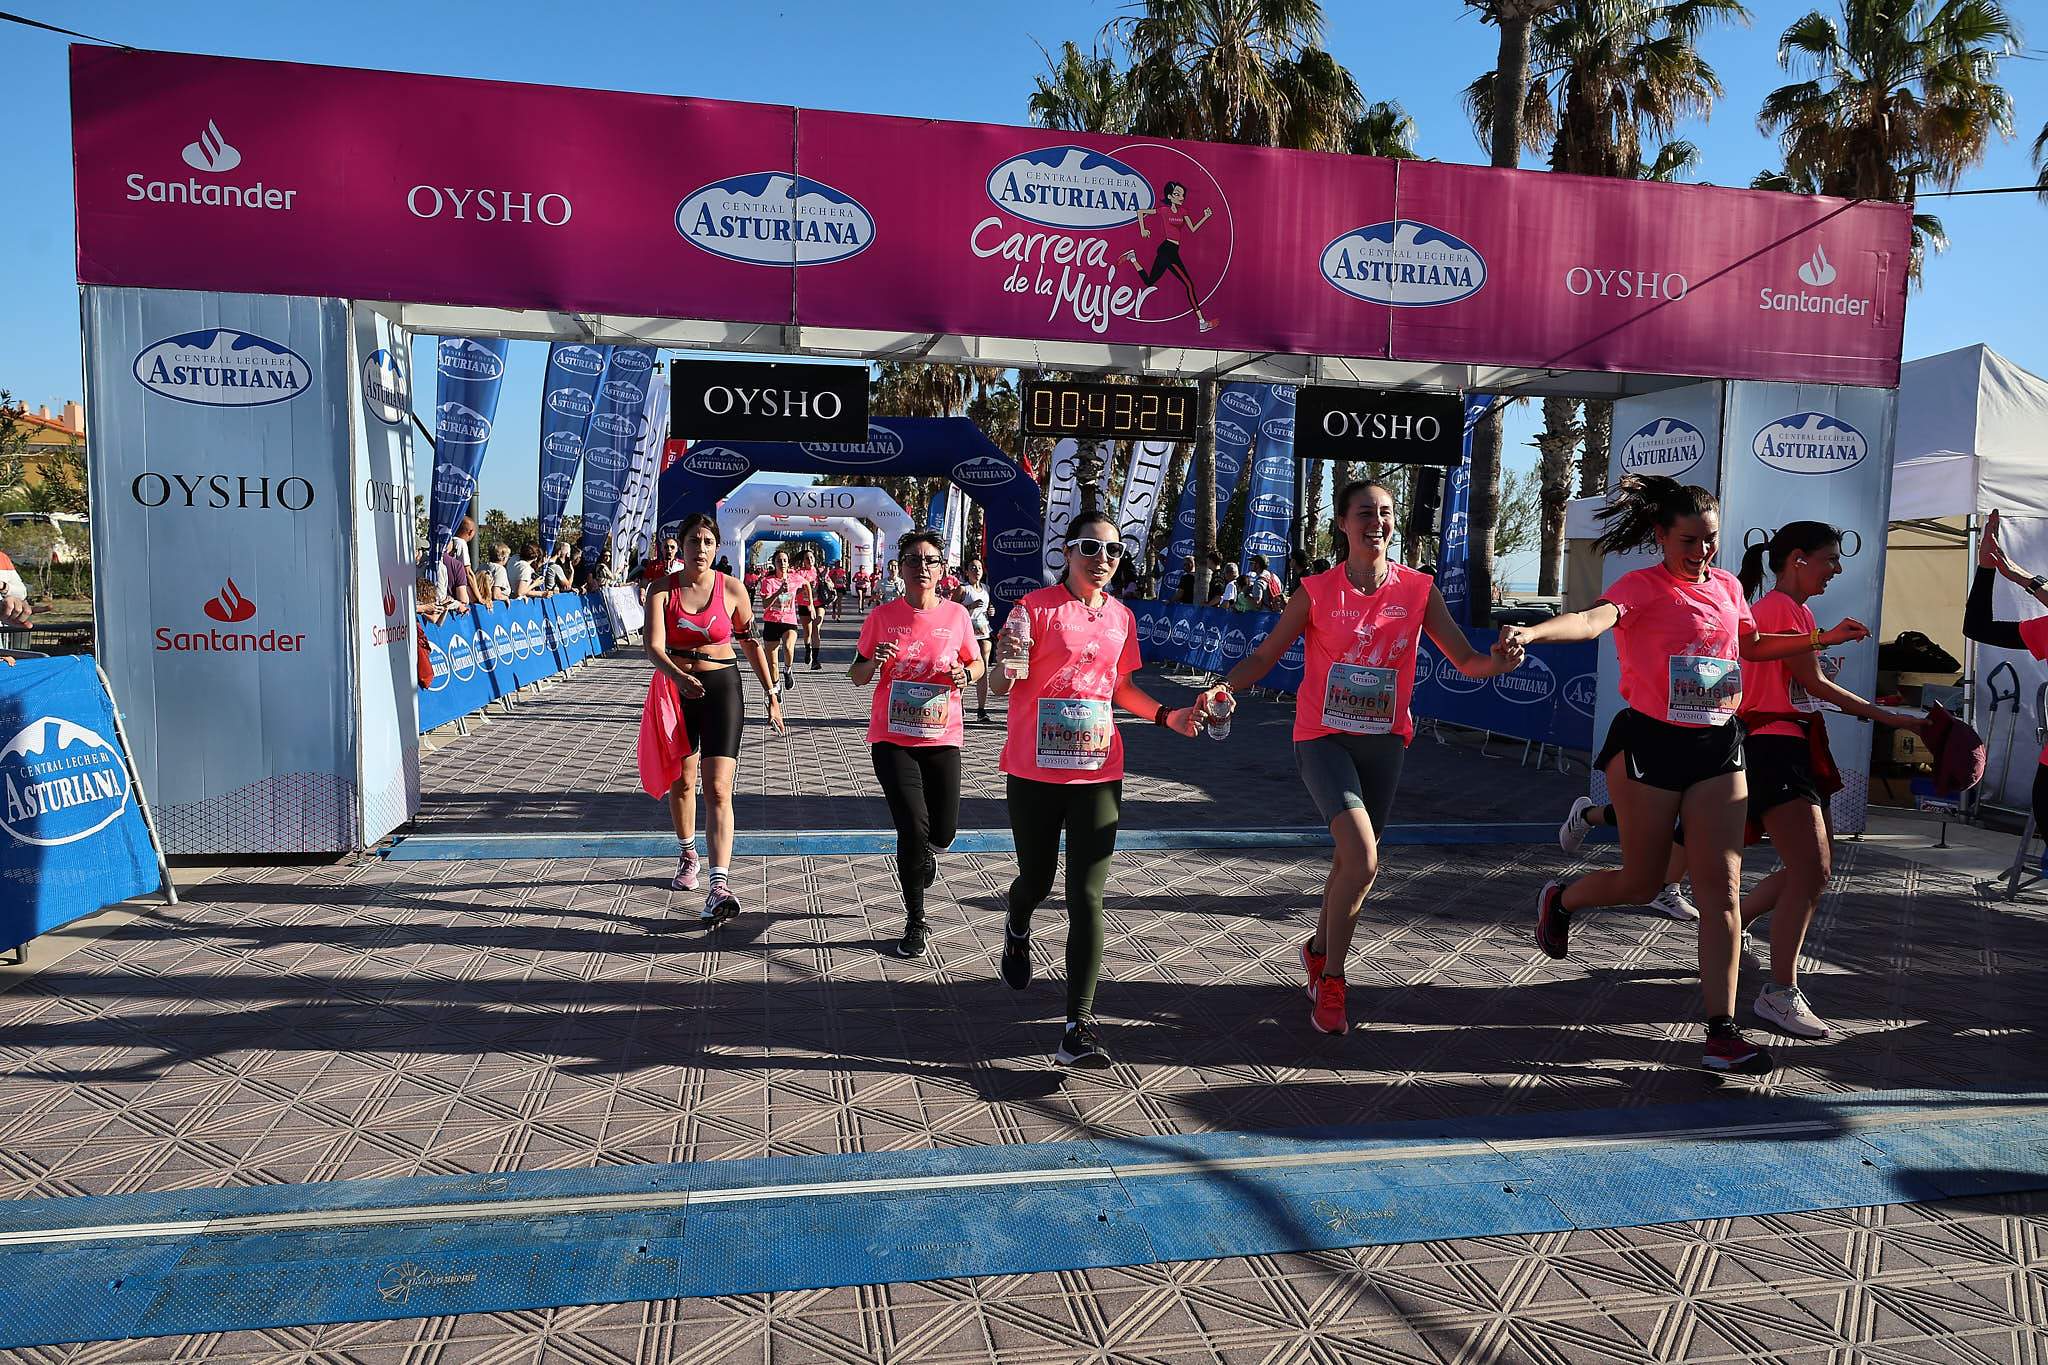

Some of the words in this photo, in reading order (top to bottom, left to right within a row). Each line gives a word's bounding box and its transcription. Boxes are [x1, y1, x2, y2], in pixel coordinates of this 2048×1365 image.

[126, 173, 296, 211] Santander
[1000, 171, 1141, 212] ASTURIANA
[1026, 171, 1079, 183] CENTRAL
[1084, 177, 1137, 188] LECHERA
[407, 184, 573, 227] OYSHO
[723, 201, 785, 214] CENTRAL
[691, 202, 860, 245] ASTURIANA
[970, 217, 1108, 268] Carrera
[1359, 247, 1412, 259] CENTRAL
[1416, 252, 1470, 263] LECHERA
[1003, 264, 1029, 293] de
[1035, 263, 1053, 295] la
[1333, 247, 1474, 288] ASTURIANA
[1048, 263, 1158, 333] Mujer
[1566, 266, 1689, 303] OYSHO
[1759, 287, 1869, 317] Santander
[147, 355, 300, 390] ASTURIANA
[175, 354, 232, 366] CENTRAL
[237, 356, 293, 368] LECHERA
[703, 385, 842, 420] OYSHO
[1034, 390, 1186, 431] 00:43:24
[1216, 427, 1247, 444] STURIANA
[1322, 410, 1441, 442] OYSHO
[1778, 433, 1815, 442] CENTRAL
[1818, 434, 1856, 442] LECHERA
[1625, 444, 1698, 468] ASTURIANA
[1760, 434, 1858, 460] ASTURIANA
[688, 457, 744, 471] ASTURIANA
[958, 468, 1012, 479] ASTURIANA
[131, 472, 316, 511] OYSHO
[366, 478, 410, 516] OYSHO
[773, 490, 856, 510] OYSHO
[155, 627, 306, 652] Santander
[20, 759, 64, 779] CENTRAL
